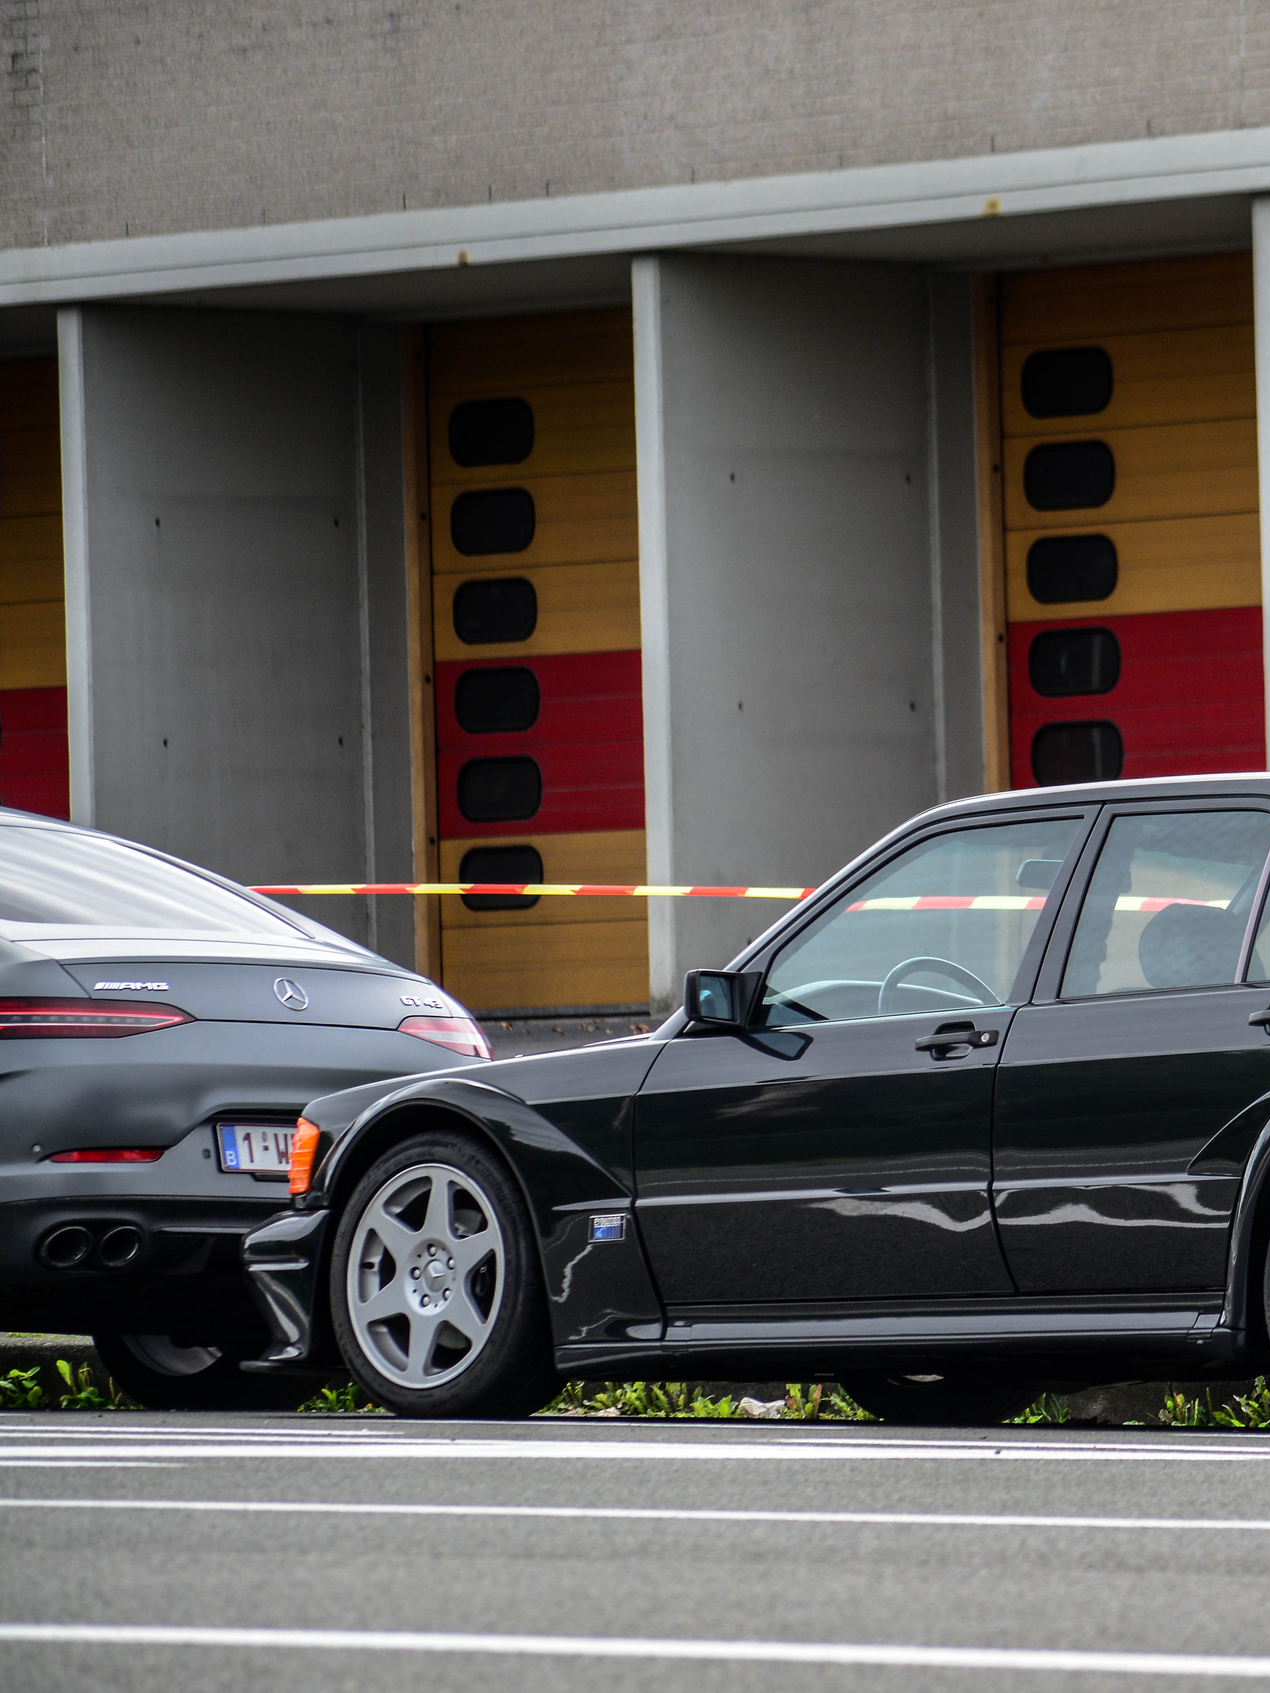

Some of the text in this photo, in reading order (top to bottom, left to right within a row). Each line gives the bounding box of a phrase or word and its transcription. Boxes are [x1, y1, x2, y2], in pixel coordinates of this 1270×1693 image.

[118, 982, 169, 991] AMG
[242, 1131, 296, 1165] 1-W
[226, 1150, 237, 1166] B
